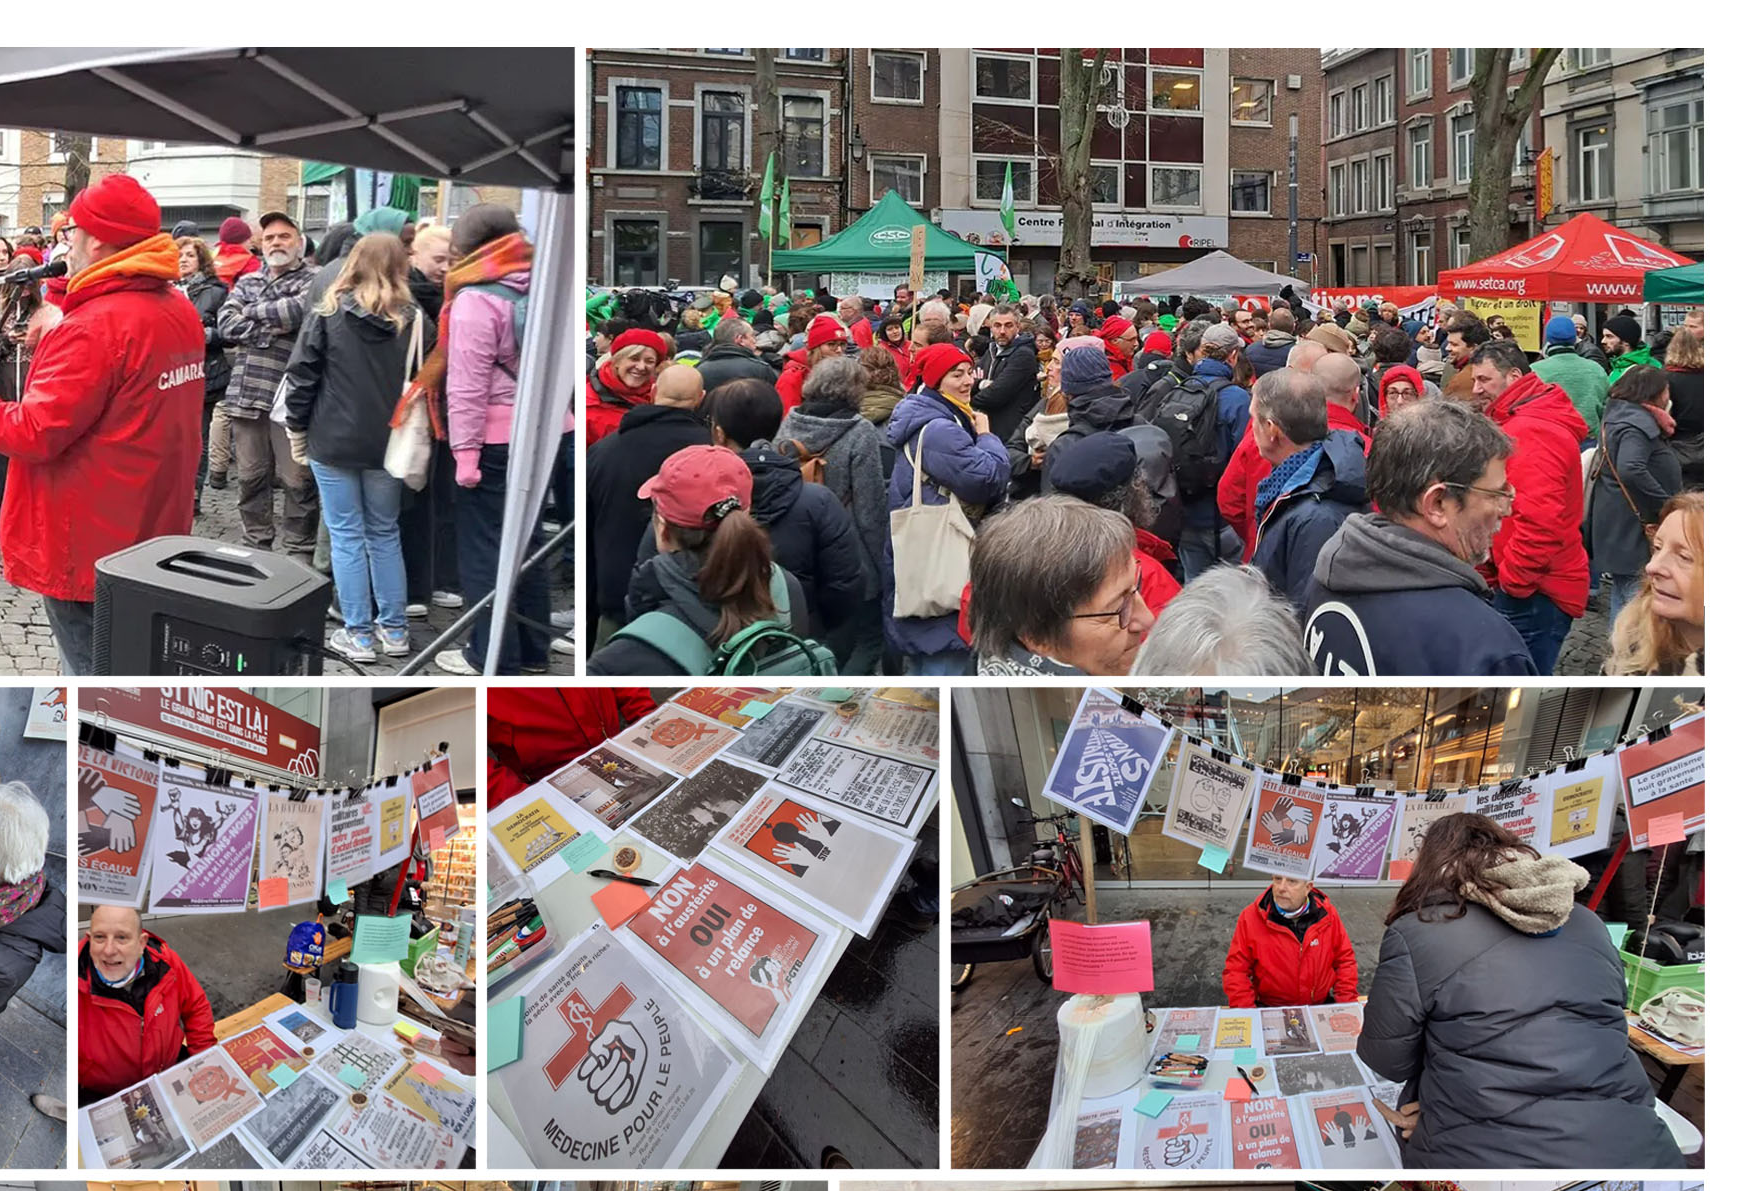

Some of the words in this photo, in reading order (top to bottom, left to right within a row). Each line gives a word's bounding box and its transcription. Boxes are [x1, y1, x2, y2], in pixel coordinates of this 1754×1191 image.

[1018, 217, 1055, 227] Centre
[1312, 290, 1384, 310] tivons
[1453, 278, 1526, 296] www.setca.org
[160, 699, 170, 710] LE
[171, 702, 195, 718] GRAND
[196, 710, 216, 725] SAINT
[216, 718, 228, 730] EST
[228, 723, 244, 736] DANS
[244, 730, 251, 740] LA
[251, 733, 268, 745] PLACE
[189, 687, 214, 713] NIC
[217, 695, 244, 725] EST
[246, 706, 262, 734] LÀ
[263, 714, 269, 735] !
[91, 753, 107, 770] LA
[111, 760, 159, 786] VICTOIRE
[1637, 776, 1648, 785] Le
[1650, 755, 1703, 780] capitalisme
[1637, 781, 1655, 793] nuit
[1657, 763, 1705, 788] gravement
[1263, 777, 1277, 790] FÊTE
[1279, 784, 1288, 793] DE
[1289, 786, 1297, 795] LA
[1297, 789, 1324, 801] VICTOIRE
[1476, 793, 1491, 805] les
[1650, 788, 1657, 797] à
[1658, 786, 1667, 795] la
[1668, 777, 1694, 793] santé
[1476, 799, 1514, 815] militaires
[91, 858, 133, 875] ÉGAUX
[817, 846, 831, 862] STOP
[647, 875, 697, 924] NON
[656, 934, 671, 948] à
[664, 878, 719, 937] l'austérité
[689, 903, 732, 947] OUI
[695, 965, 711, 980] à
[706, 945, 725, 968] un
[721, 916, 746, 951] plan
[739, 902, 758, 921] de
[725, 926, 764, 978] relance
[524, 1018, 533, 1027] la
[533, 1001, 549, 1020] sécu
[548, 988, 564, 1004] avec
[571, 970, 582, 982] fric
[592, 942, 611, 961] riches
[539, 993, 549, 1004] de
[548, 976, 566, 994] santé
[565, 954, 588, 980] gratuits
[786, 959, 804, 987] FGTB
[644, 997, 672, 1058] PEUPLE
[656, 1063, 672, 1088] LE
[622, 1090, 663, 1145] POUR
[1234, 1114, 1242, 1125] à
[1243, 1110, 1286, 1124] l'austérité
[1244, 1099, 1275, 1113] NON
[543, 1118, 620, 1162] MEDECINE
[1237, 1140, 1244, 1151] à
[1245, 1140, 1258, 1151] un
[1259, 1137, 1279, 1150] plan
[1279, 1133, 1291, 1145] de
[1249, 1123, 1276, 1139] OUI
[1248, 1147, 1282, 1161] relance
